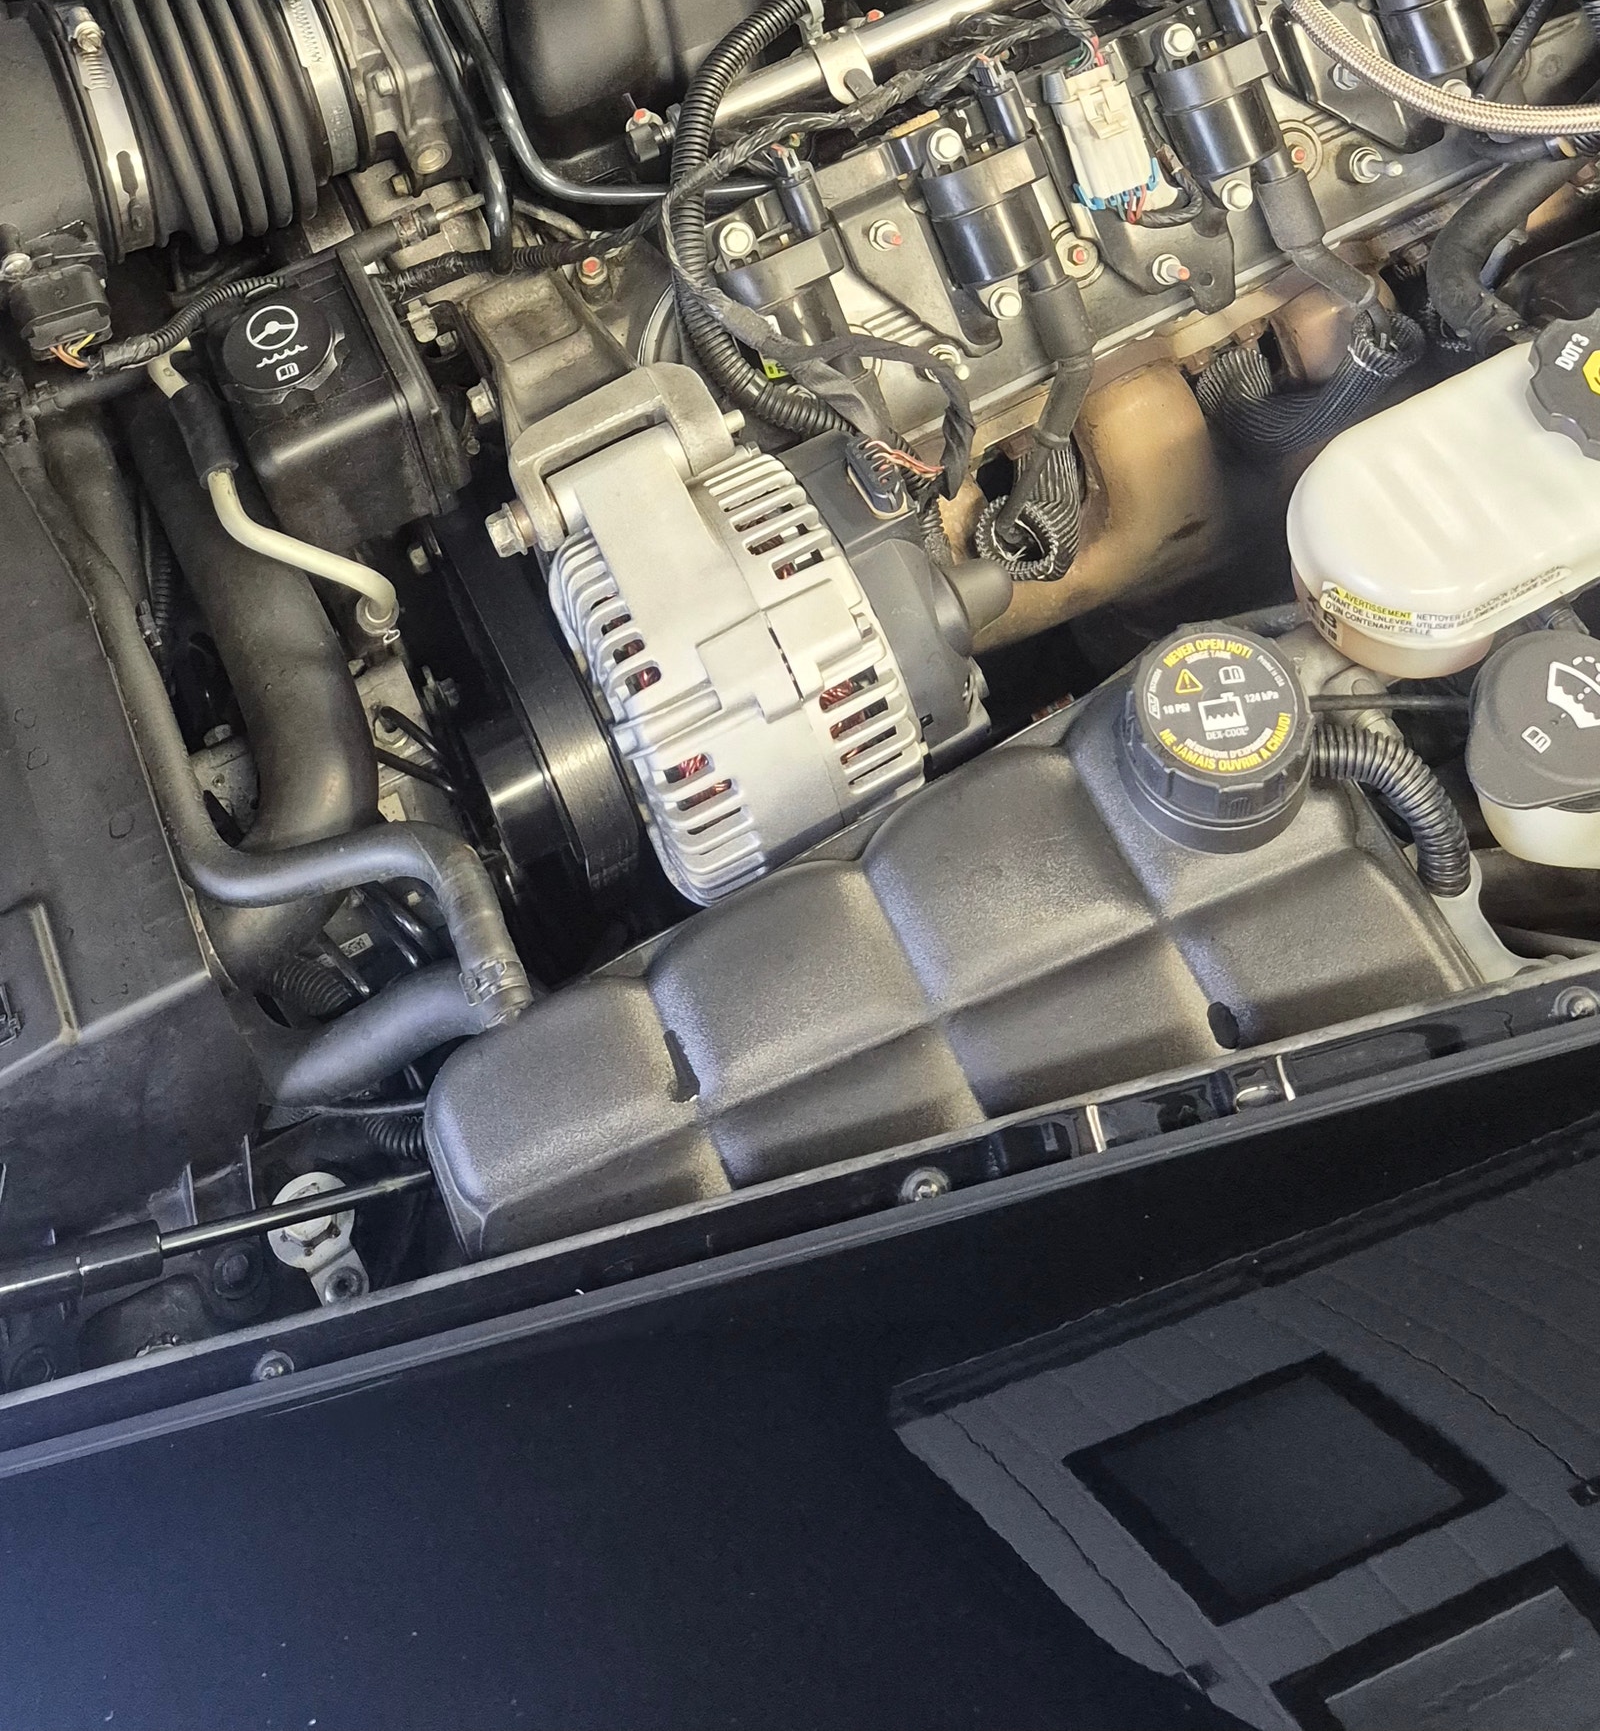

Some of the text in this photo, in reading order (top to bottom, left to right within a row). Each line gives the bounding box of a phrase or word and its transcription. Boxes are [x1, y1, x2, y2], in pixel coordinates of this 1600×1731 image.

[1325, 600, 1344, 616] D'UN
[1345, 611, 1397, 631] CONTENANT
[1328, 591, 1352, 612] AVANT
[1353, 606, 1363, 616] DE
[1416, 621, 1455, 631] UTILISER
[1344, 591, 1412, 619] AVERTISSEMENT
[1416, 612, 1461, 622] NETTOYER
[1462, 608, 1473, 619] LE
[1162, 638, 1254, 668] NEVER OPEN HOT!
[1174, 702, 1191, 714] PSI
[1243, 690, 1279, 704] 124 hPa
[1159, 728, 1178, 746] NE
[1172, 743, 1216, 769] JAMAIS
[1218, 750, 1262, 771] OUVRIR
[1266, 712, 1292, 751] CHAUD!
